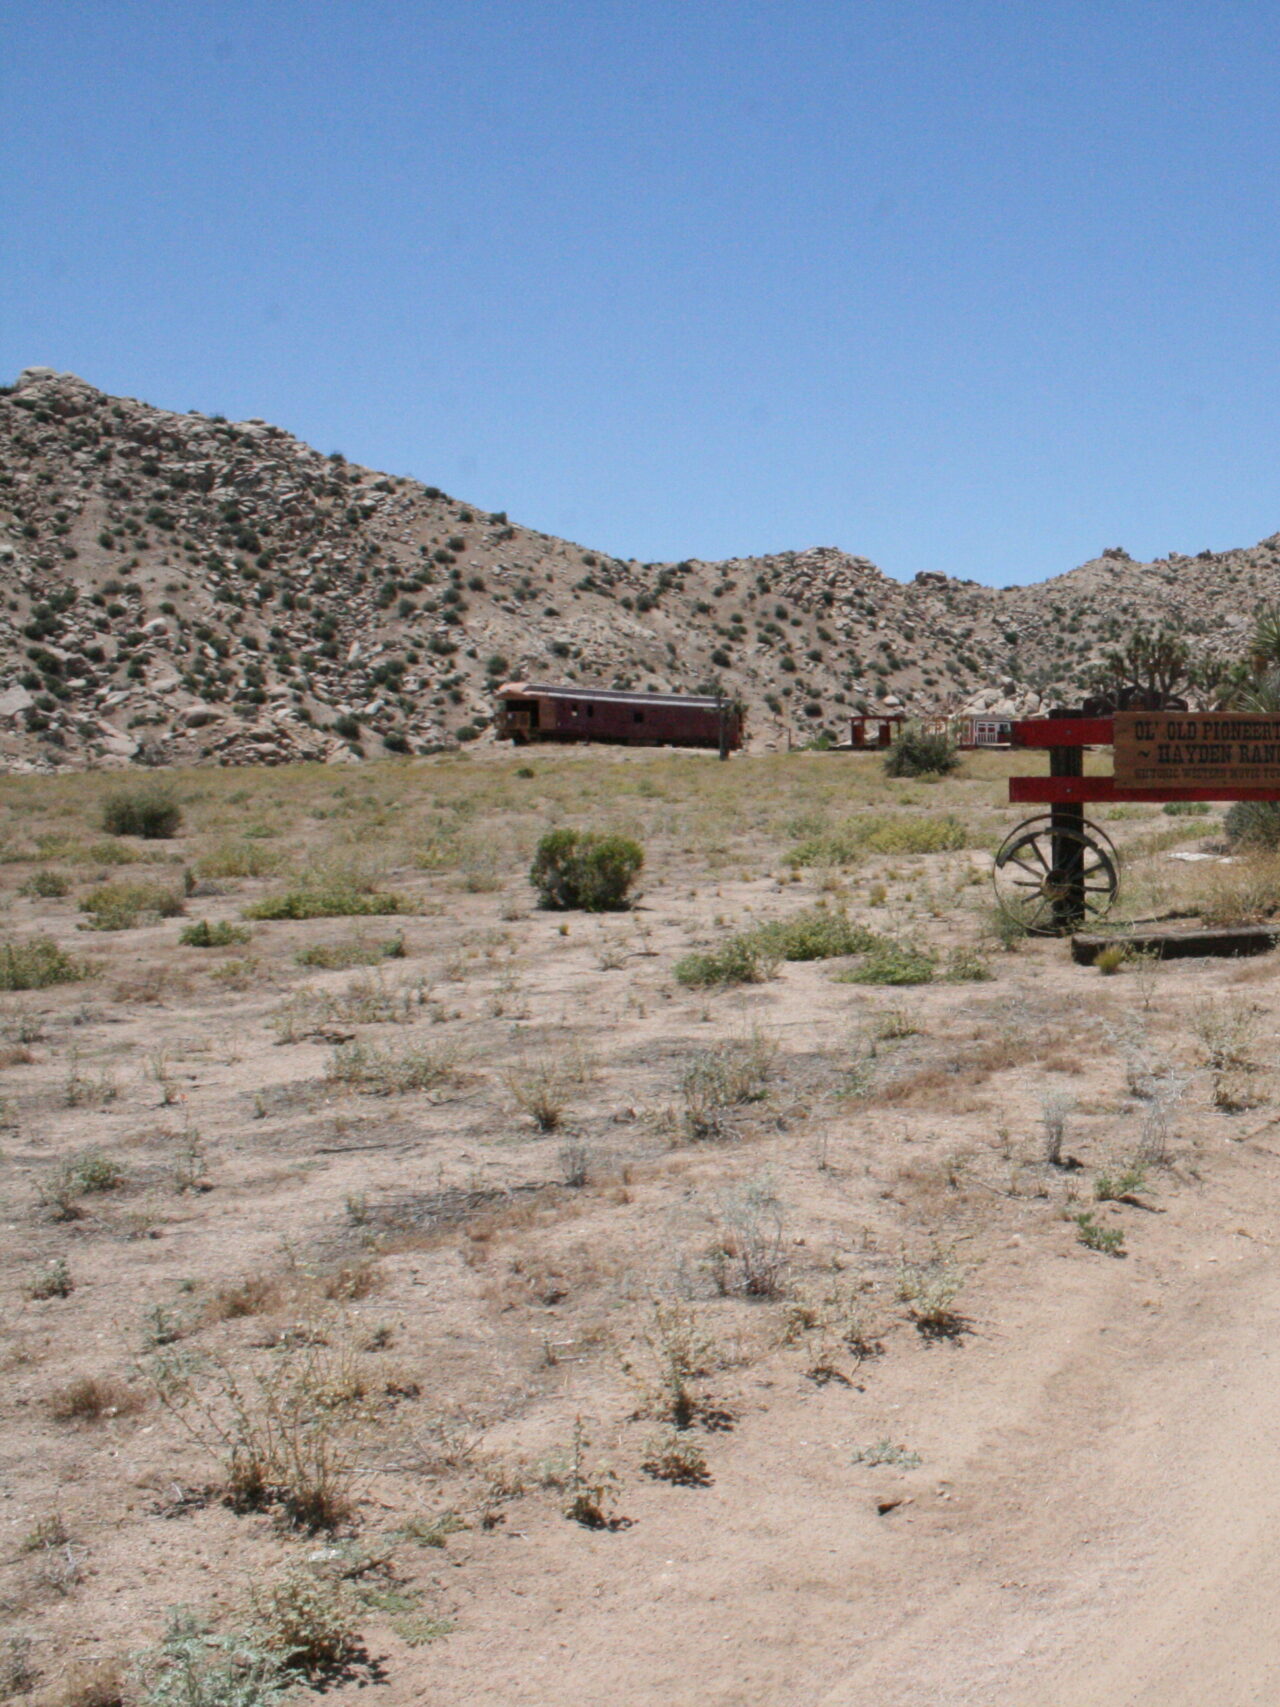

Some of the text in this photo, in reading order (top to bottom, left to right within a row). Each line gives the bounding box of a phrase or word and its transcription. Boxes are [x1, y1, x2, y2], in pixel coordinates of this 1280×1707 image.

[1135, 720, 1159, 741] OL'
[1167, 720, 1197, 741] OLD
[1157, 744, 1232, 763] HAYDEN
